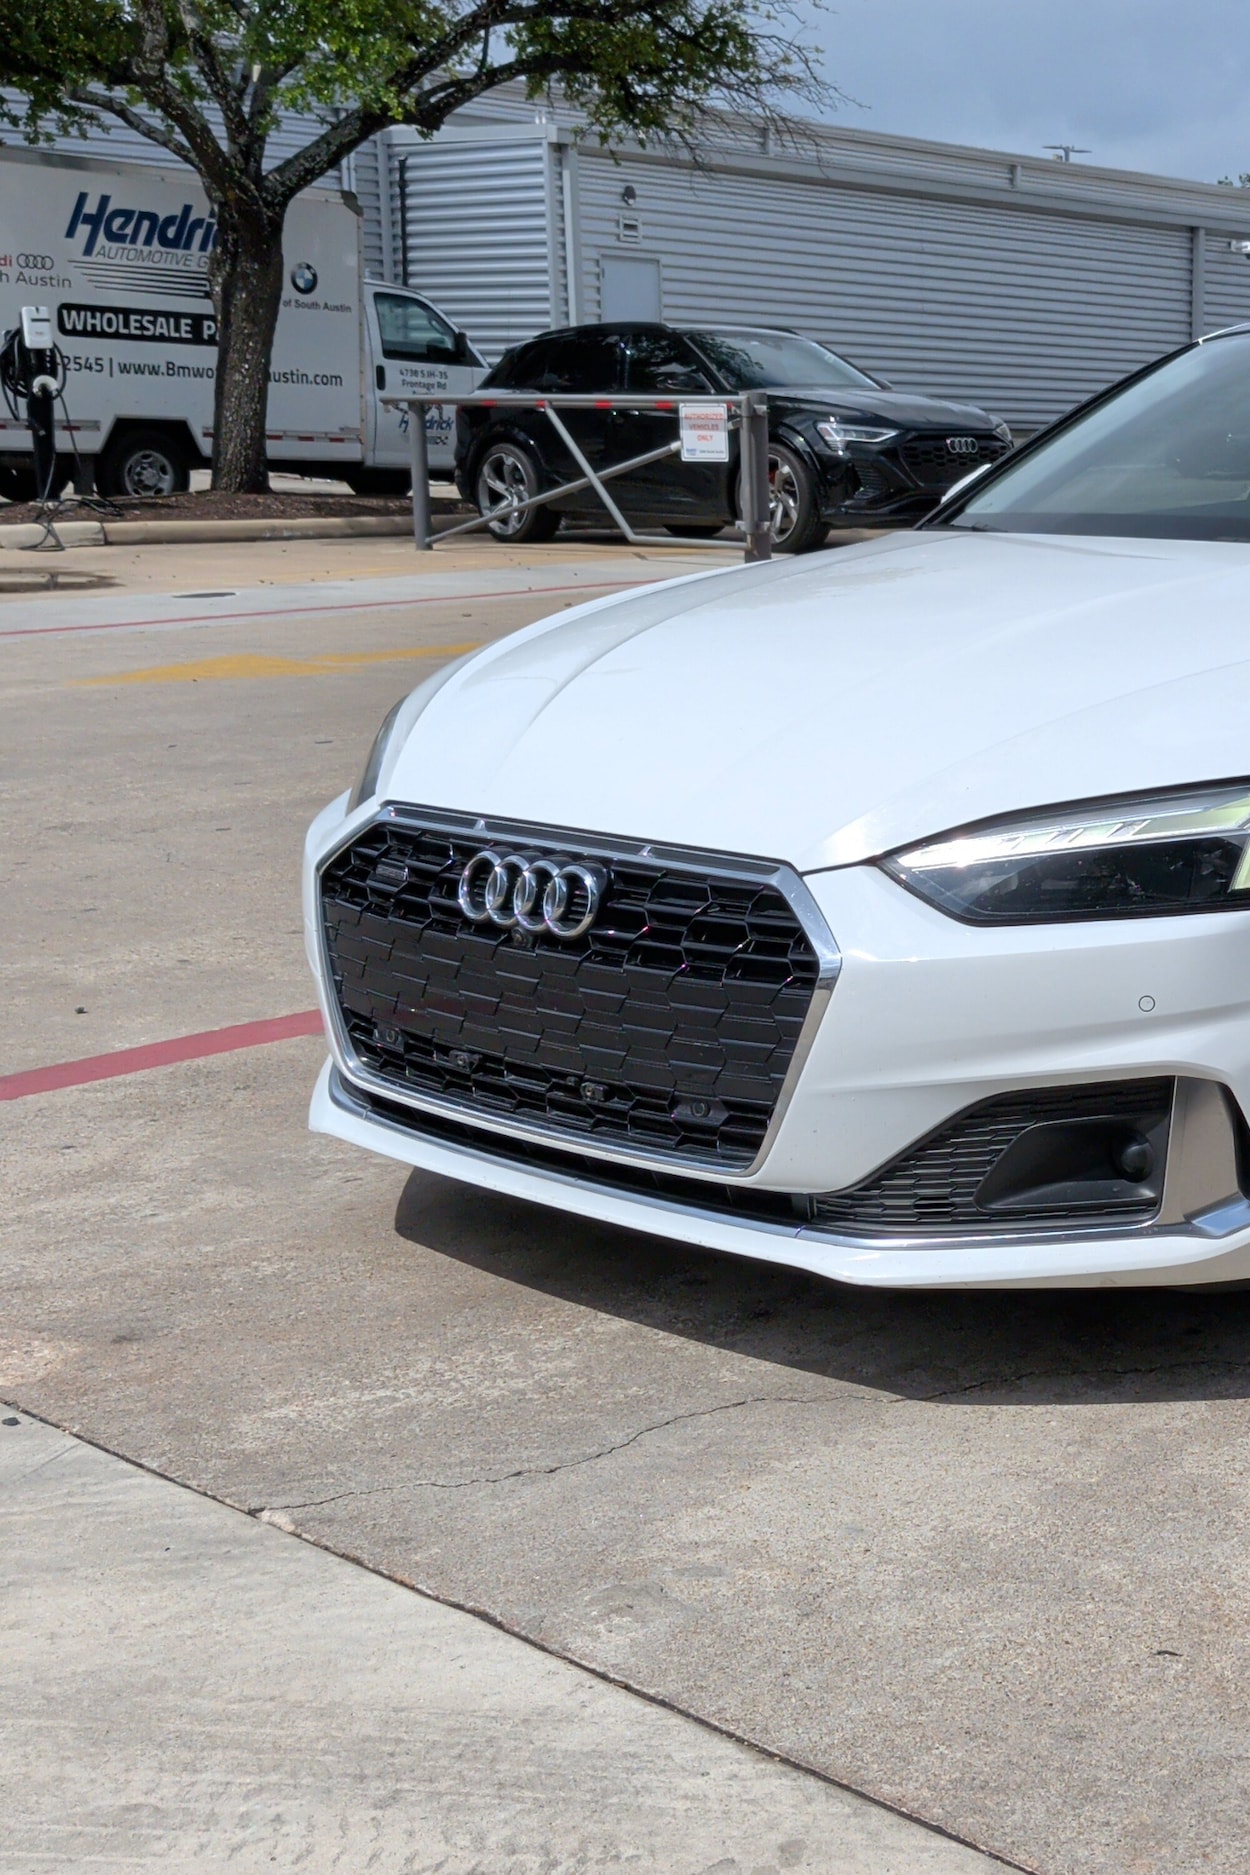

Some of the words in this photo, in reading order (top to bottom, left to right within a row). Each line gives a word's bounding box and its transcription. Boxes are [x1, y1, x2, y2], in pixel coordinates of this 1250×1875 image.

[95, 245, 193, 268] AUTOMOTIVE
[16, 271, 72, 288] Austin
[282, 299, 293, 308] of
[295, 299, 321, 310] South
[323, 302, 352, 313] Austin
[62, 309, 193, 339] WHOLESALE
[401, 379, 435, 391] Frontage
[437, 381, 447, 390] Rd
[398, 413, 454, 433] Hdrick
[689, 423, 719, 431] VEHICLES
